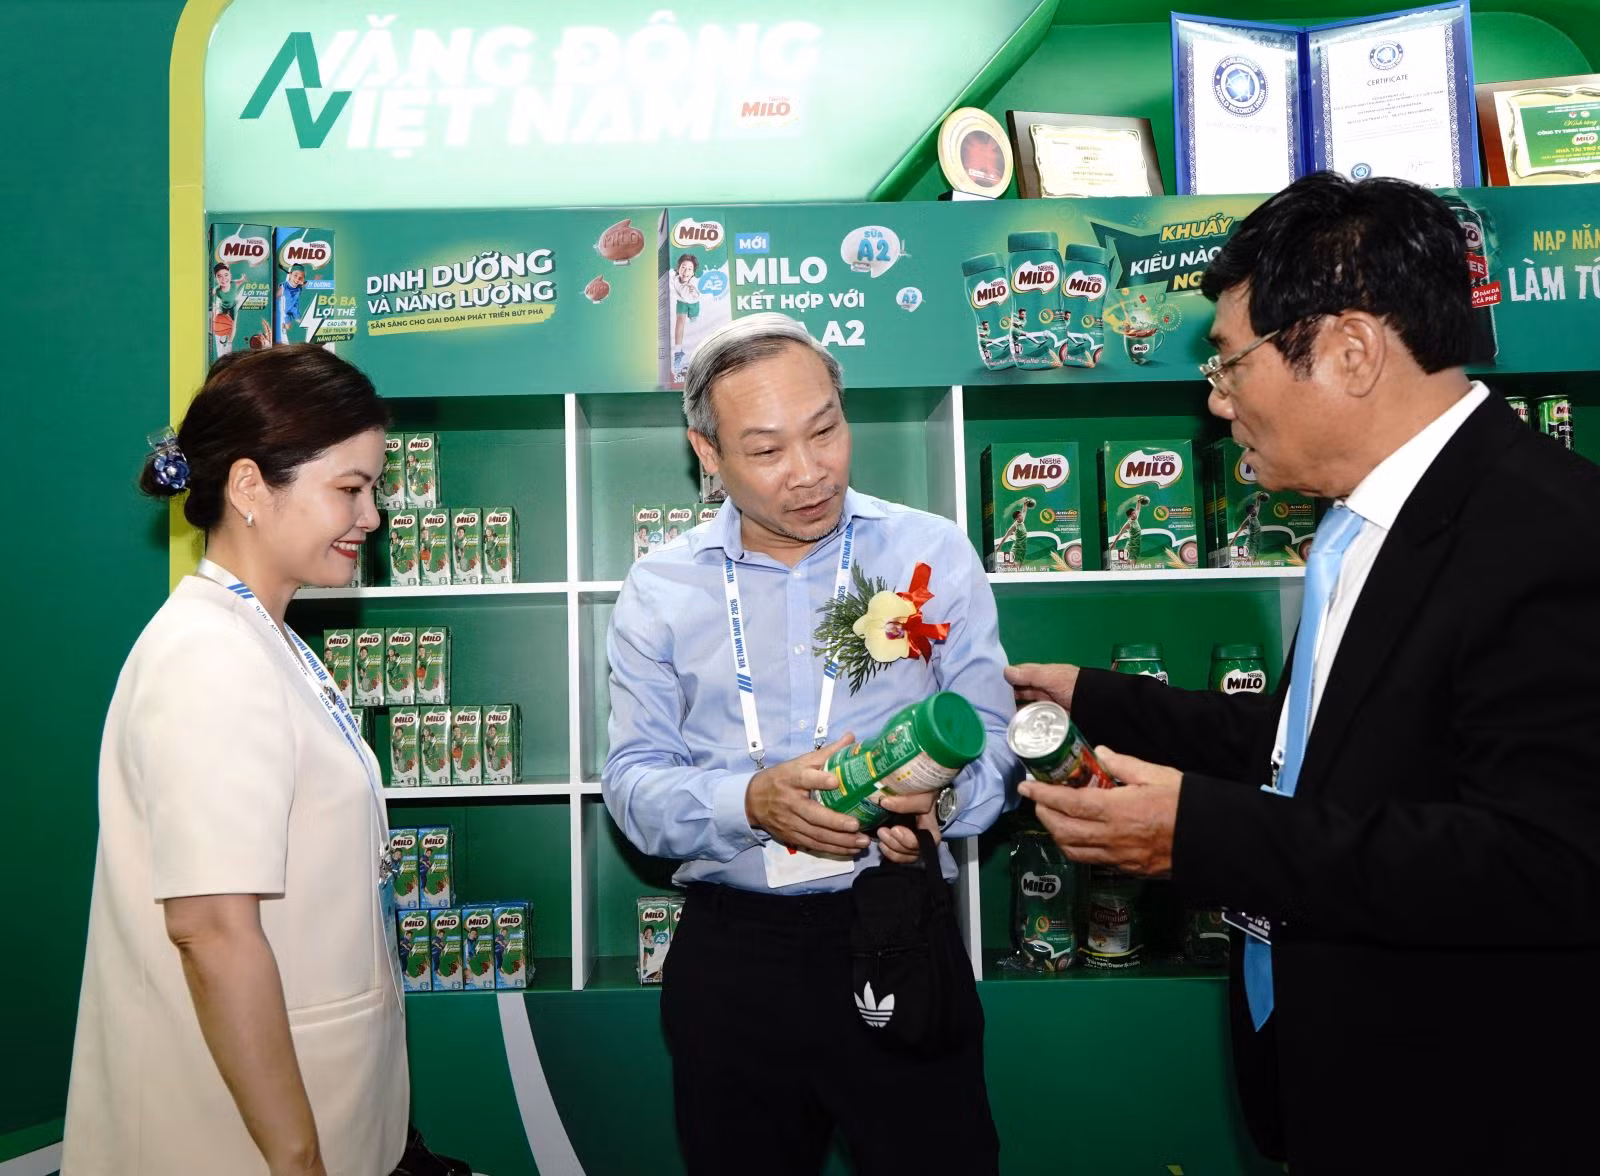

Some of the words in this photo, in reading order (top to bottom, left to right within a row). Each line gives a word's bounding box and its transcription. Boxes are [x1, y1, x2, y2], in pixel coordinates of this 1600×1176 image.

[1366, 74, 1409, 87] CERTIFICATE
[1215, 84, 1230, 107] WORLD
[506, 87, 716, 145] NAM
[741, 101, 791, 117] MILO
[678, 226, 718, 241] MILO
[864, 228, 884, 238] SỮA
[1161, 213, 1233, 242] KHUẤY
[224, 243, 264, 257] MILO
[740, 236, 767, 250] MỚI
[856, 238, 891, 262] A2
[1533, 230, 1567, 256] NẠP
[288, 246, 326, 260] MILO
[1130, 250, 1176, 277] KIỂU
[366, 268, 425, 295] DINH
[432, 249, 554, 287] DƯỠNG
[736, 256, 828, 286] MILO
[1018, 270, 1055, 285] MILO
[702, 278, 722, 290] A2
[1068, 278, 1101, 293] MILO
[1507, 257, 1567, 302] LÀM
[368, 294, 391, 314] VÀ
[396, 290, 453, 313] NĂNG
[460, 280, 554, 309] LƯỢNG
[737, 288, 775, 311] KẾT
[780, 292, 824, 313] HỢP
[826, 288, 865, 308] VỚI
[902, 294, 918, 305] A2
[976, 285, 1006, 302] MILO
[340, 296, 356, 306] BA
[387, 316, 408, 328] SÀNG
[409, 318, 426, 326] CHO
[427, 316, 442, 325] GIAI
[468, 311, 487, 321] PHÁT
[488, 308, 510, 319] TRIỂN
[512, 308, 526, 318] BỨT
[528, 307, 544, 316] PHÁ
[820, 319, 866, 347] A2
[410, 441, 430, 449] MILO
[1040, 458, 1062, 466] Nestlé
[1012, 464, 1063, 480] MILO
[1126, 461, 1176, 478] MILO
[424, 517, 444, 525] MILO
[456, 516, 476, 524] MILO
[640, 512, 658, 520] MILO
[670, 512, 690, 520] MILO
[840, 541, 852, 570] VIETNAM
[724, 558, 736, 584] VIETNA
[732, 616, 743, 637] DAIRY
[328, 636, 348, 645] MILO
[359, 636, 380, 644] MILO
[391, 635, 411, 644] MILO
[422, 634, 442, 643] MILO
[734, 637, 748, 670] VIETNAM
[303, 651, 328, 682] VIETNAM
[1226, 678, 1263, 690] MILO
[394, 715, 414, 724] MILO
[425, 714, 446, 723] MILO
[457, 713, 476, 722] MILO
[488, 713, 508, 722] MILO
[392, 838, 413, 846] MILO
[424, 837, 444, 846] MILO
[1022, 878, 1056, 894] MILO
[404, 920, 425, 928] MILO
[436, 919, 457, 927] MILO
[468, 918, 489, 926] MILO
[500, 917, 520, 925] MILO
